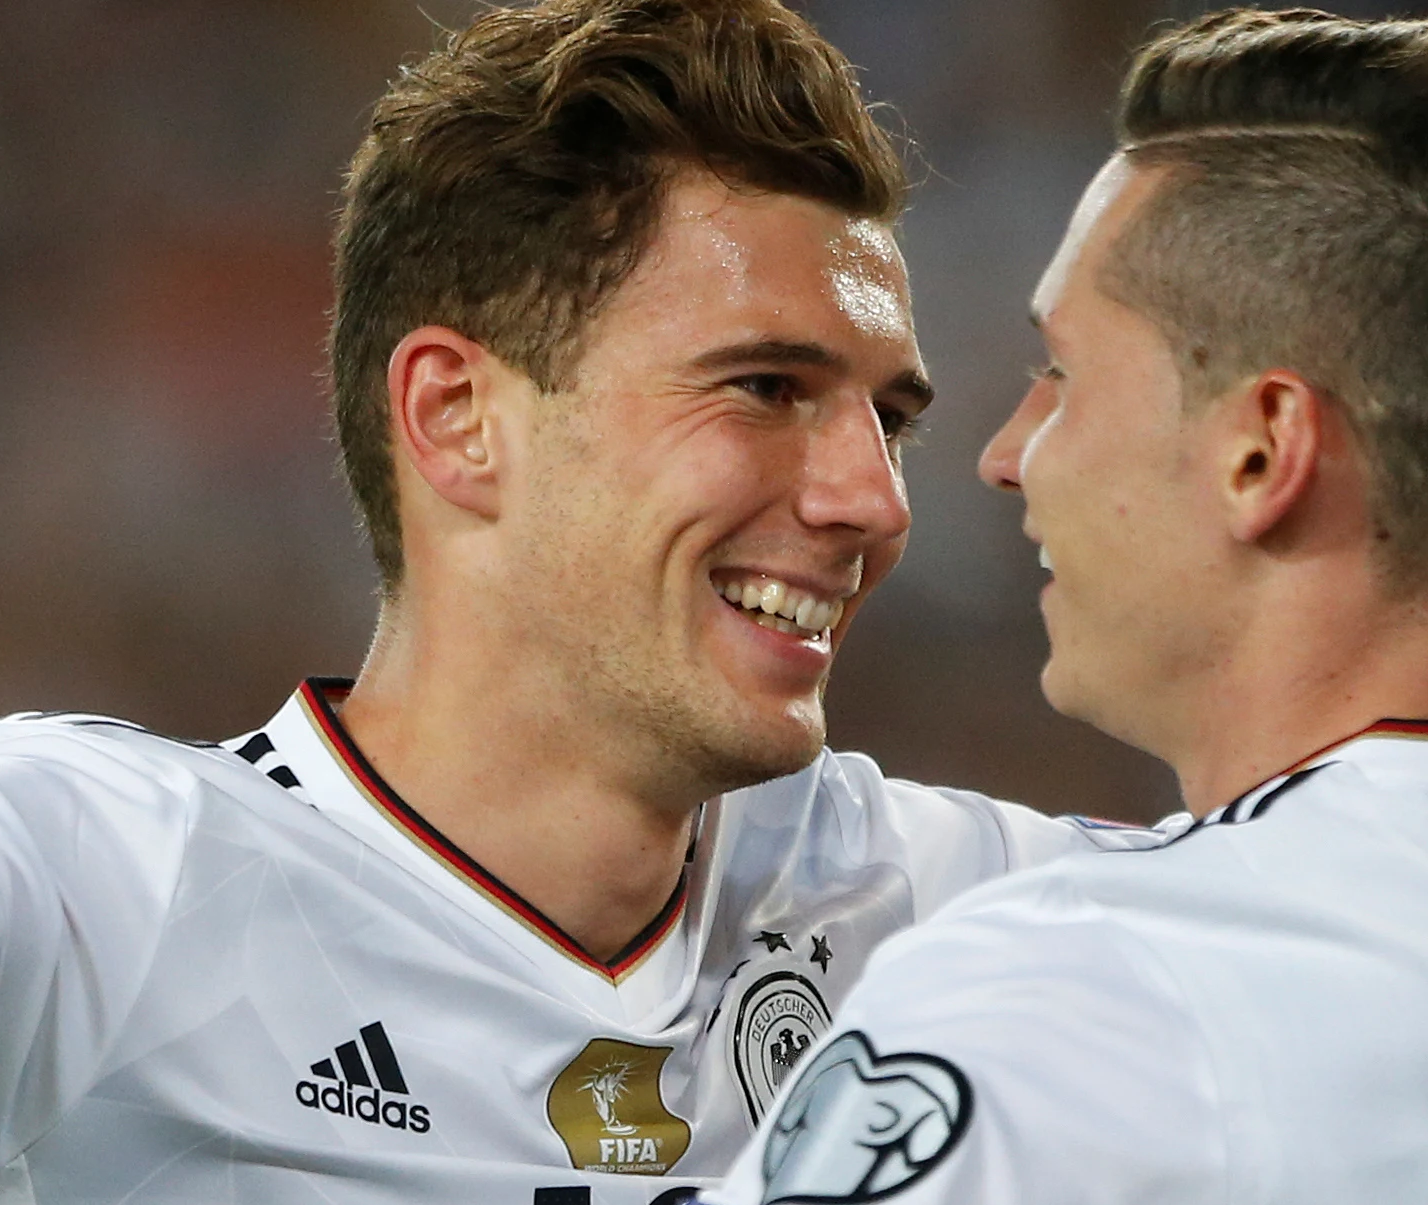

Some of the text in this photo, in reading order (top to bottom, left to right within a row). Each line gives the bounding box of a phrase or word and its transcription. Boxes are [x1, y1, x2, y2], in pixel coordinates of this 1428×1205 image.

[750, 999, 815, 1043] DEUTSCHER
[296, 1080, 431, 1133] adidas
[599, 1138, 657, 1163] FIFA
